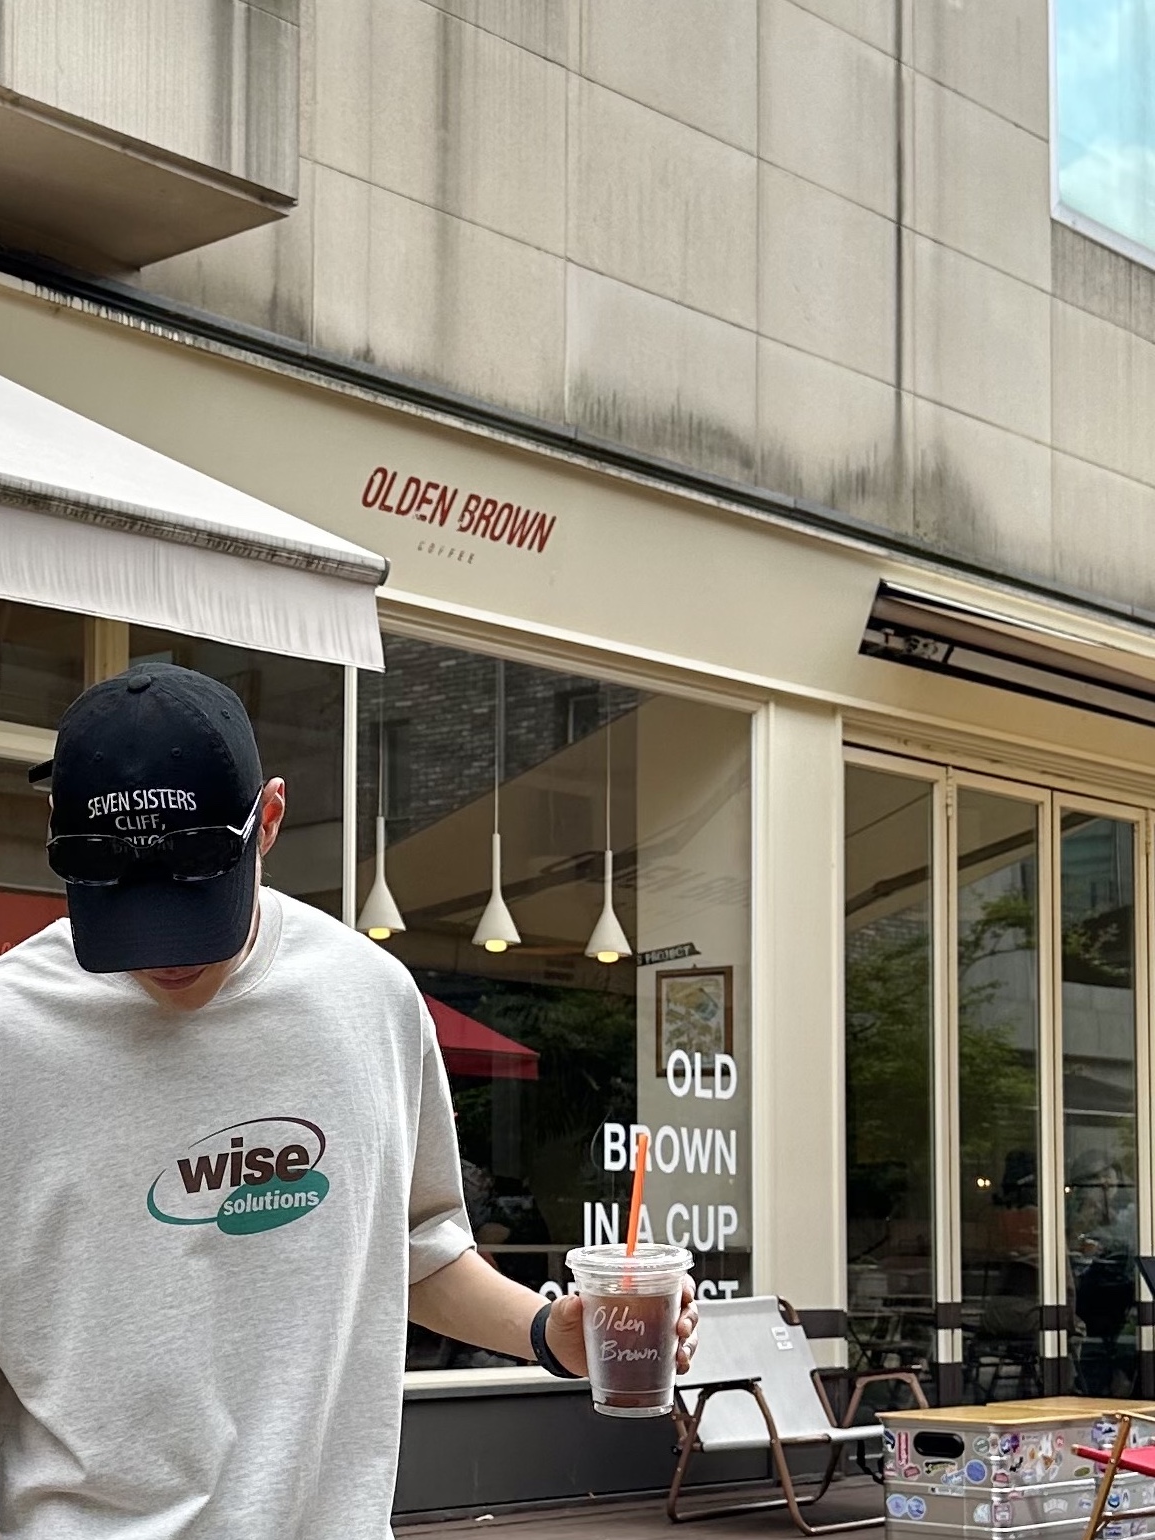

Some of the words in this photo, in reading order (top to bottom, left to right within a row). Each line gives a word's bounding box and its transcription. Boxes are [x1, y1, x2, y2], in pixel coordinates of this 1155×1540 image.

[361, 467, 458, 528] OLDEN
[456, 493, 557, 553] BROWN
[417, 540, 476, 565] COFFEE
[87, 790, 130, 819] SEVEN
[132, 788, 197, 811] SISTERS
[114, 813, 166, 831] CLIFF,
[666, 1049, 738, 1101] OLD
[177, 1136, 310, 1194] wise
[603, 1122, 737, 1175] BROWN
[223, 1189, 319, 1216] solutions
[583, 1202, 620, 1247] IN
[665, 1202, 738, 1252] CUP
[592, 1305, 646, 1336] Olden
